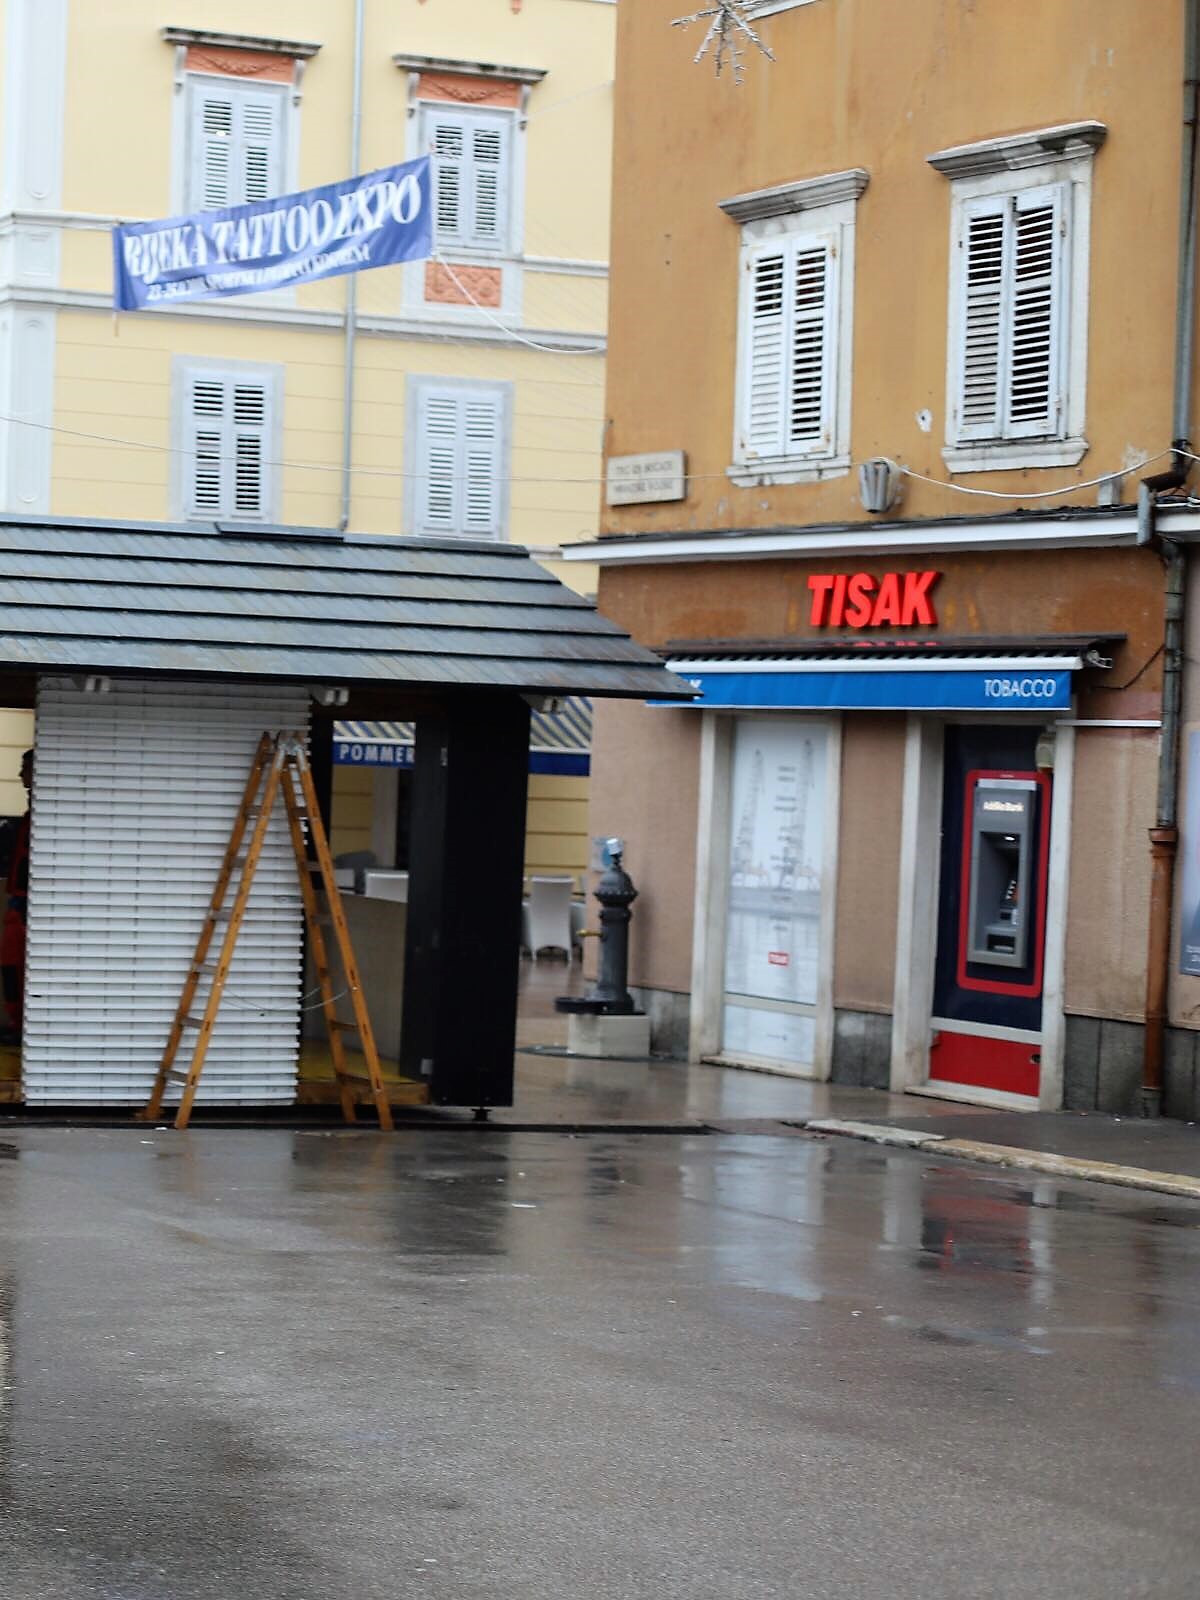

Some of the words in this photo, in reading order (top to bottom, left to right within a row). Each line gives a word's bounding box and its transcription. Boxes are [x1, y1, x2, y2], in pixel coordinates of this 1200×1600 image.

[123, 224, 208, 285] RIJEKA
[211, 199, 334, 265] TATTOO
[335, 174, 422, 239] EXPO
[807, 571, 938, 627] TISAK
[983, 678, 1057, 699] TOBACCO
